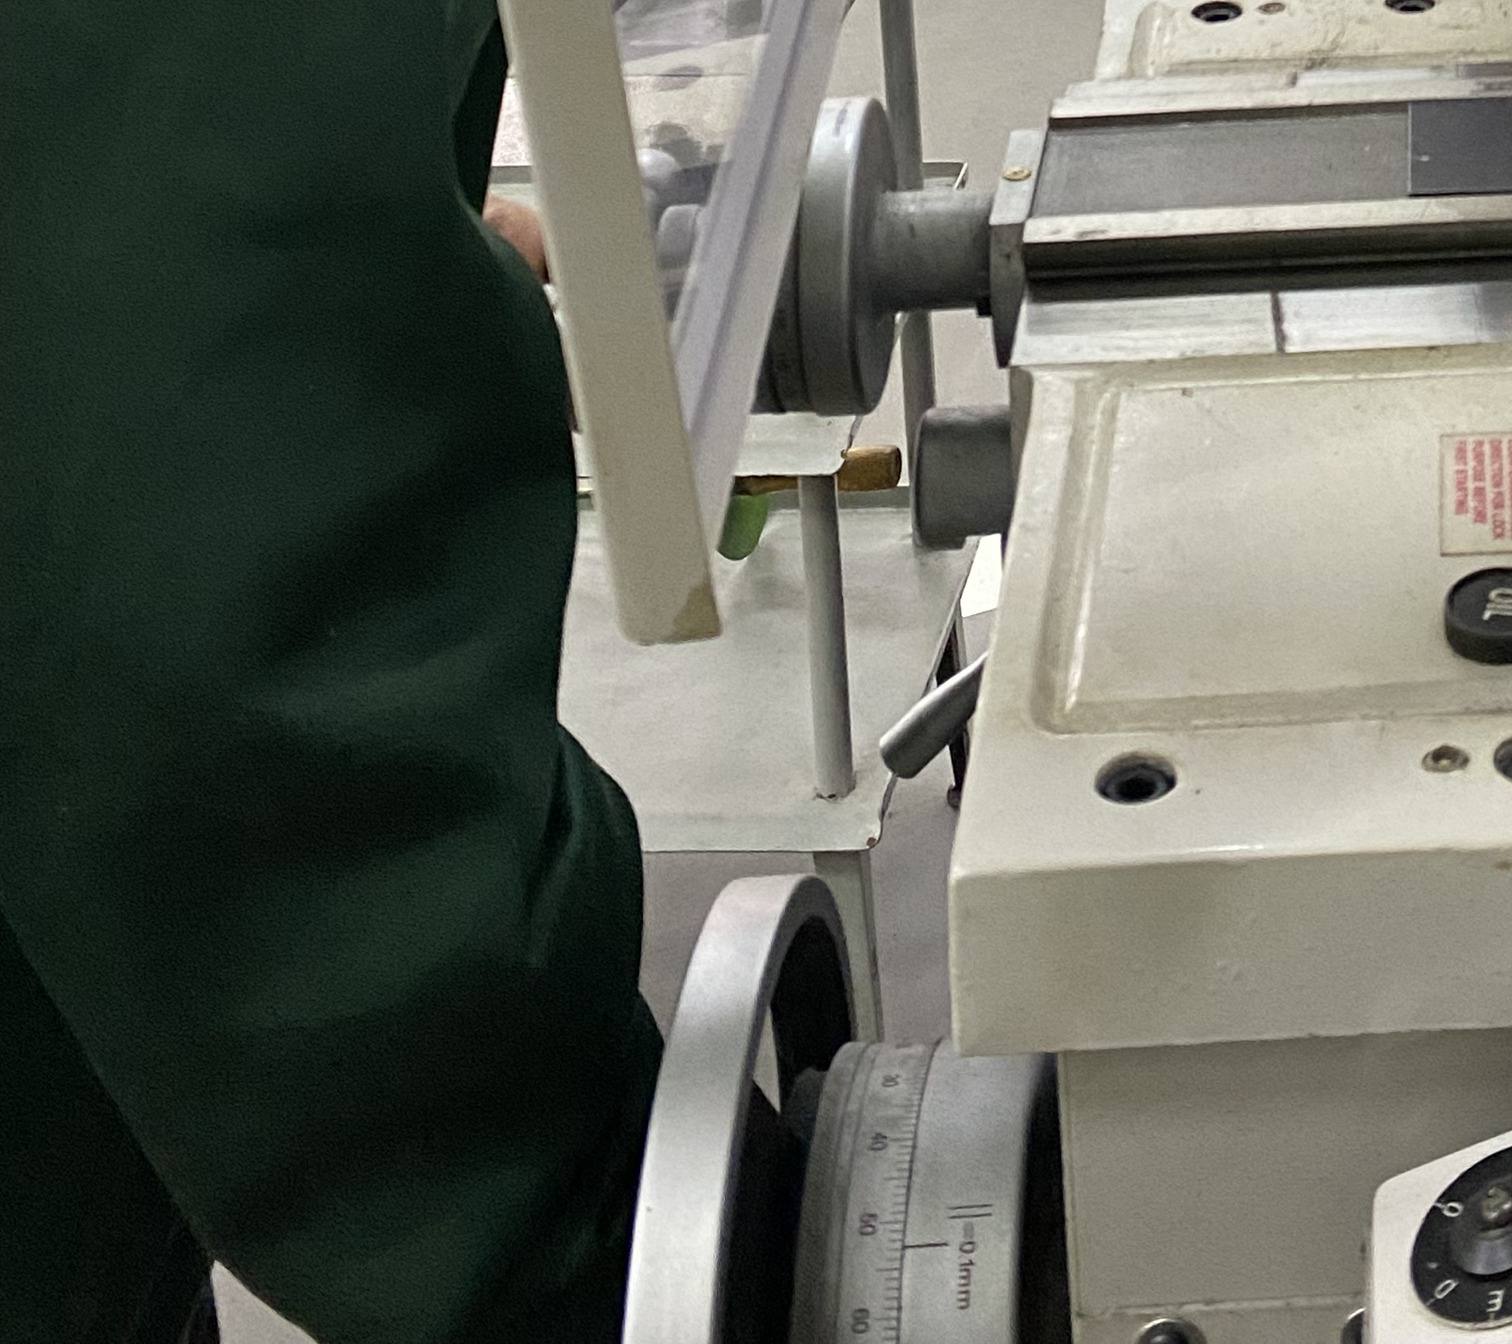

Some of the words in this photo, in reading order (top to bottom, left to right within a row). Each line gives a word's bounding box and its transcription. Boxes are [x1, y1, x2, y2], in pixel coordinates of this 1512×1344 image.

[870, 1132, 888, 1151] 40
[859, 1213, 878, 1236] 50
[852, 1308, 871, 1334] 60
